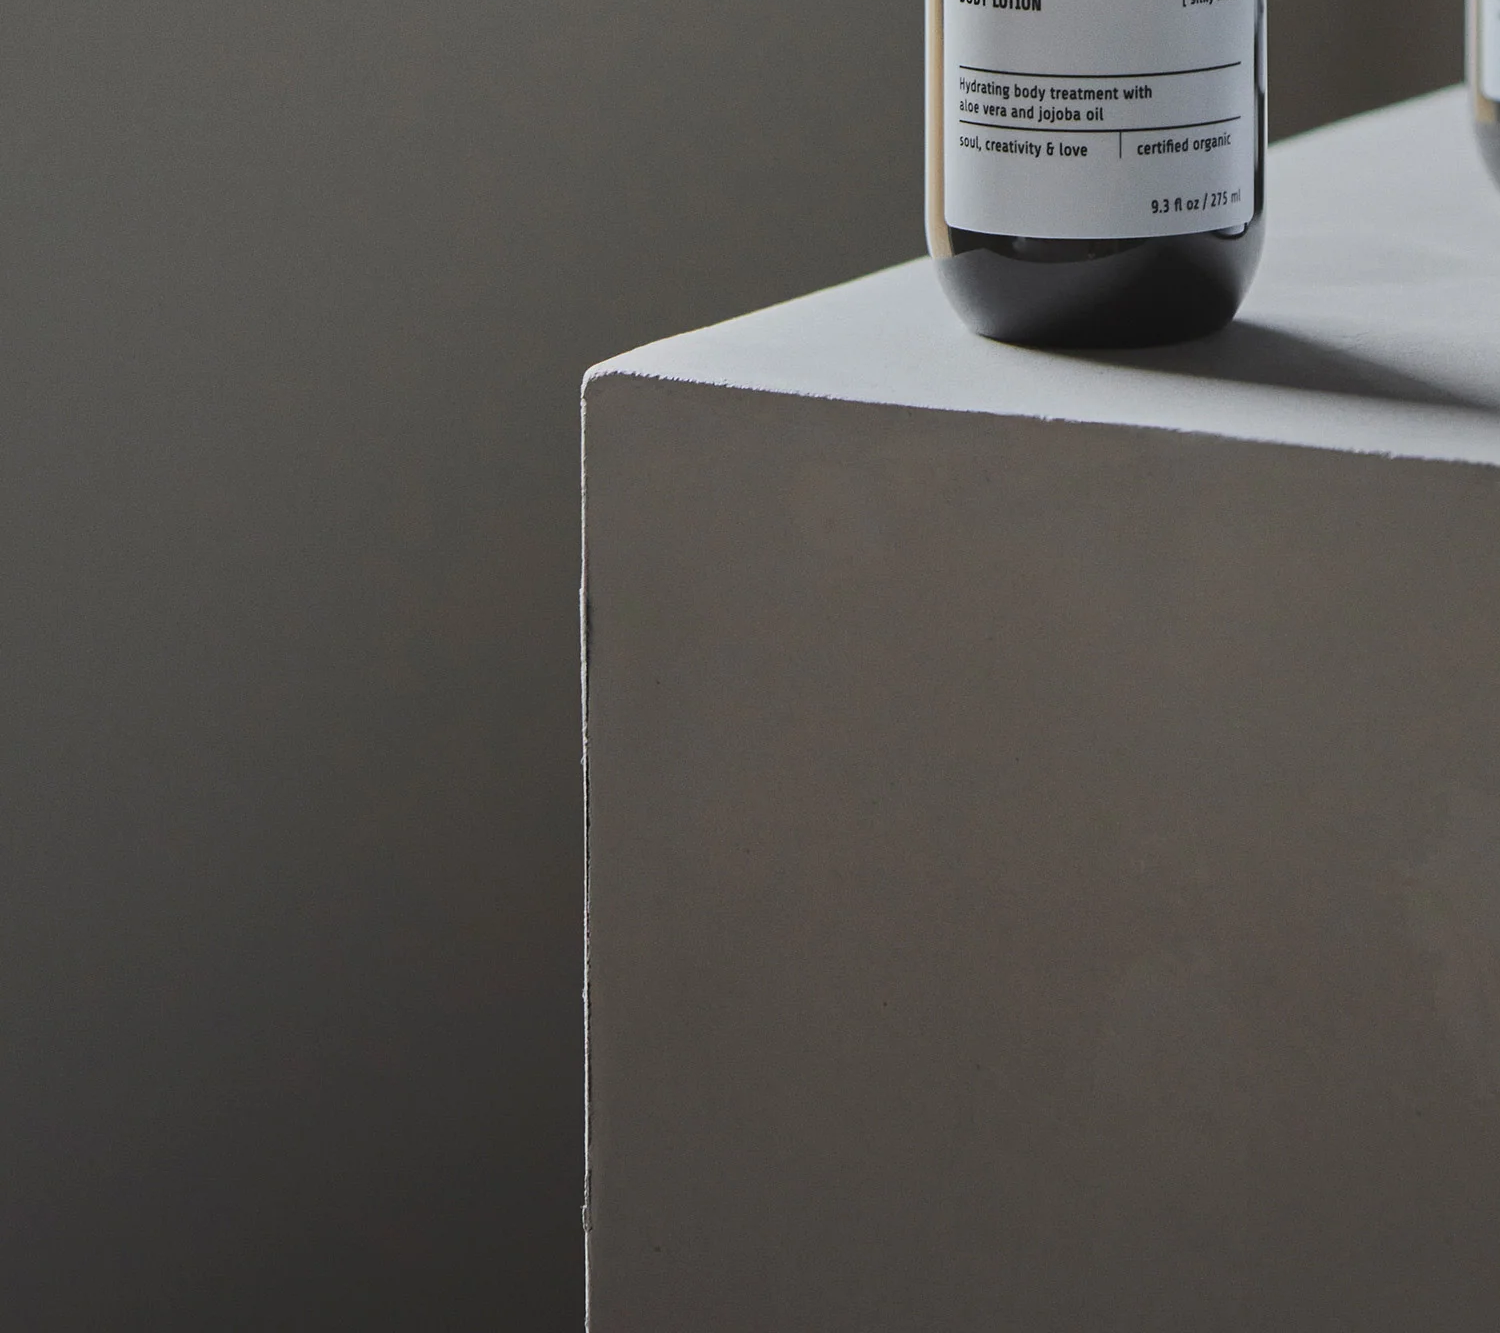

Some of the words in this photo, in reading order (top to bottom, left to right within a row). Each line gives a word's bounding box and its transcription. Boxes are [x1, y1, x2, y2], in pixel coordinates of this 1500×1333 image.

[960, 77, 1010, 99] Hydrating
[1014, 83, 1045, 101] body
[1050, 87, 1118, 100] treatment
[1123, 85, 1152, 100] with
[960, 99, 979, 114] aloe
[983, 104, 1007, 117] vera
[1011, 106, 1034, 119] and
[1038, 107, 1081, 123] jojoba
[1086, 107, 1103, 121] oil
[960, 135, 982, 151] soul,
[985, 139, 1041, 158] creativity
[1046, 142, 1054, 155] &
[1059, 143, 1088, 157] love
[1137, 138, 1189, 155] certified
[1193, 133, 1231, 152] organic
[1151, 199, 1169, 214] 9.3
[1174, 197, 1182, 212] fl
[1186, 199, 1199, 210] oz
[1211, 191, 1227, 207] 275
[1231, 189, 1241, 203] ml
